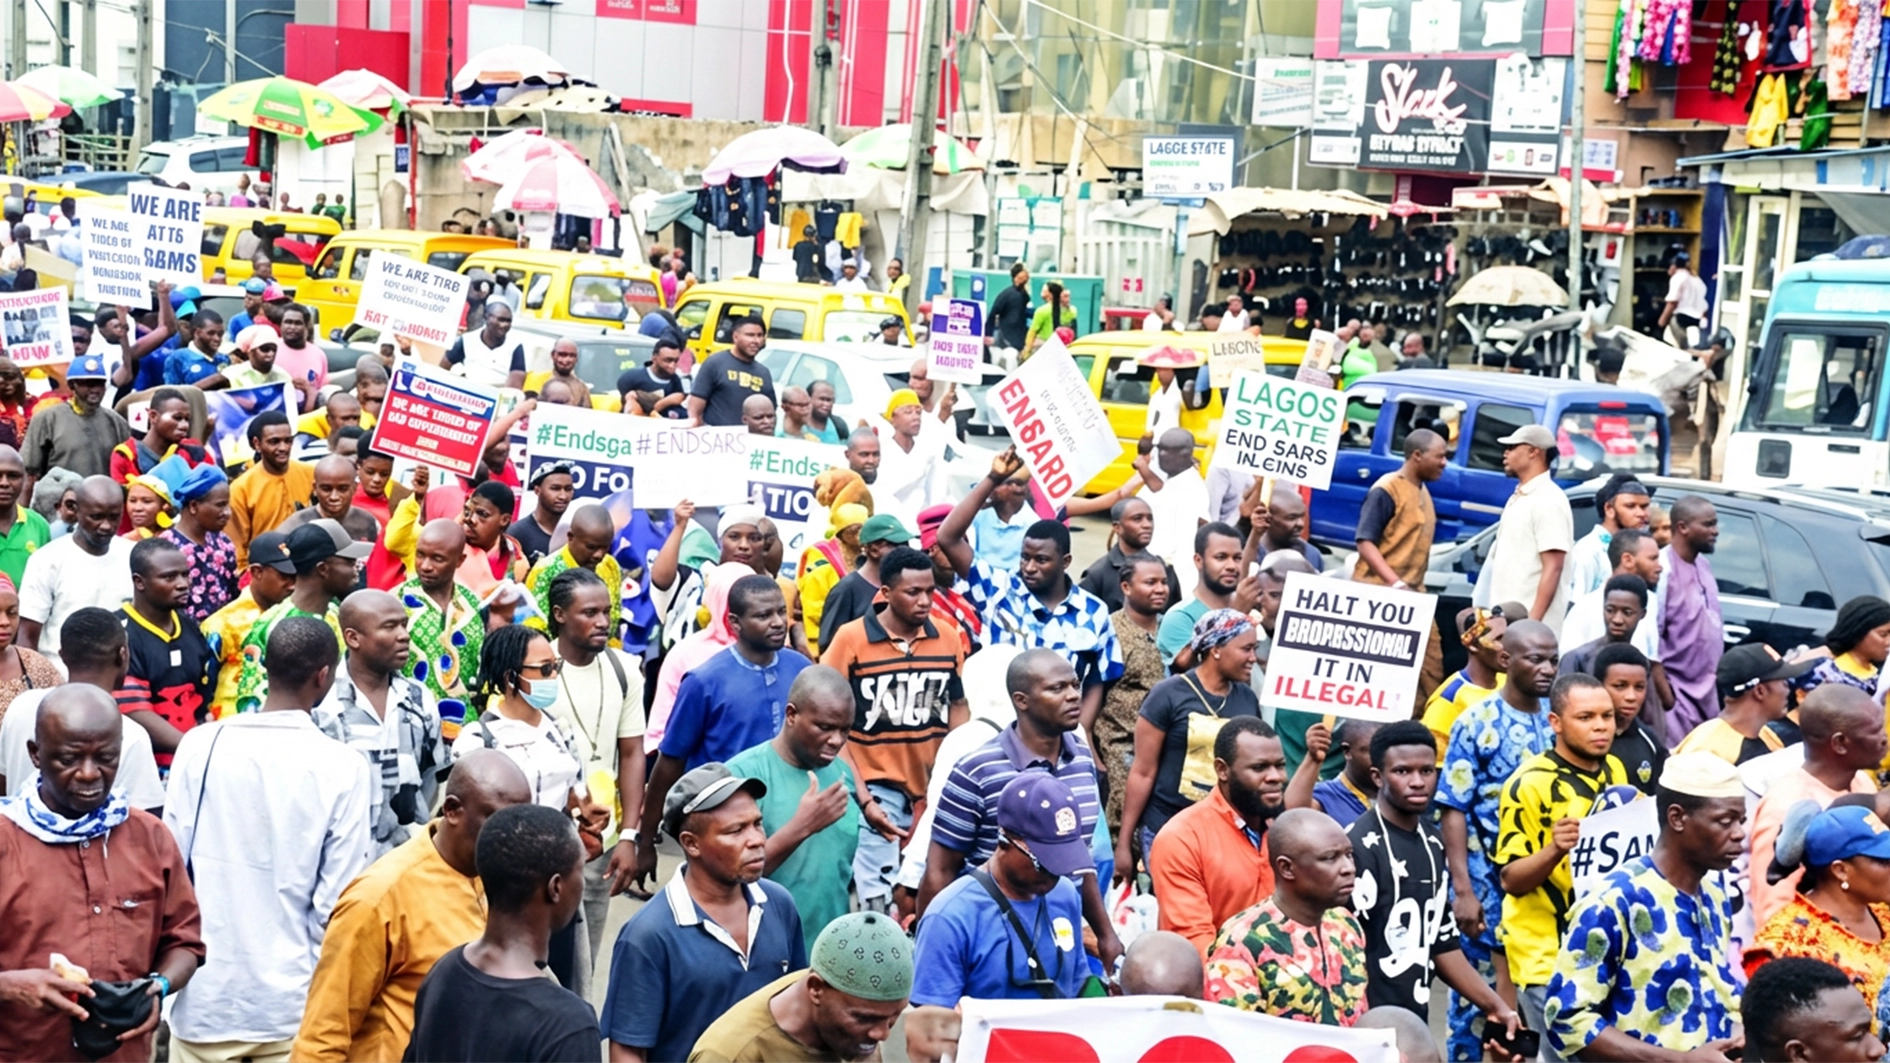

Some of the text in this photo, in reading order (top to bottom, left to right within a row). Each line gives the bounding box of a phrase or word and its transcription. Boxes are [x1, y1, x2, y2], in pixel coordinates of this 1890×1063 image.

[131, 193, 202, 223] WE ARE
[1237, 377, 1338, 423] LAGOS
[1235, 408, 1330, 445] STATE
[1225, 428, 1328, 466] END SARS
[1296, 588, 1415, 625] HALT YOU
[1312, 657, 1373, 684] IT IN
